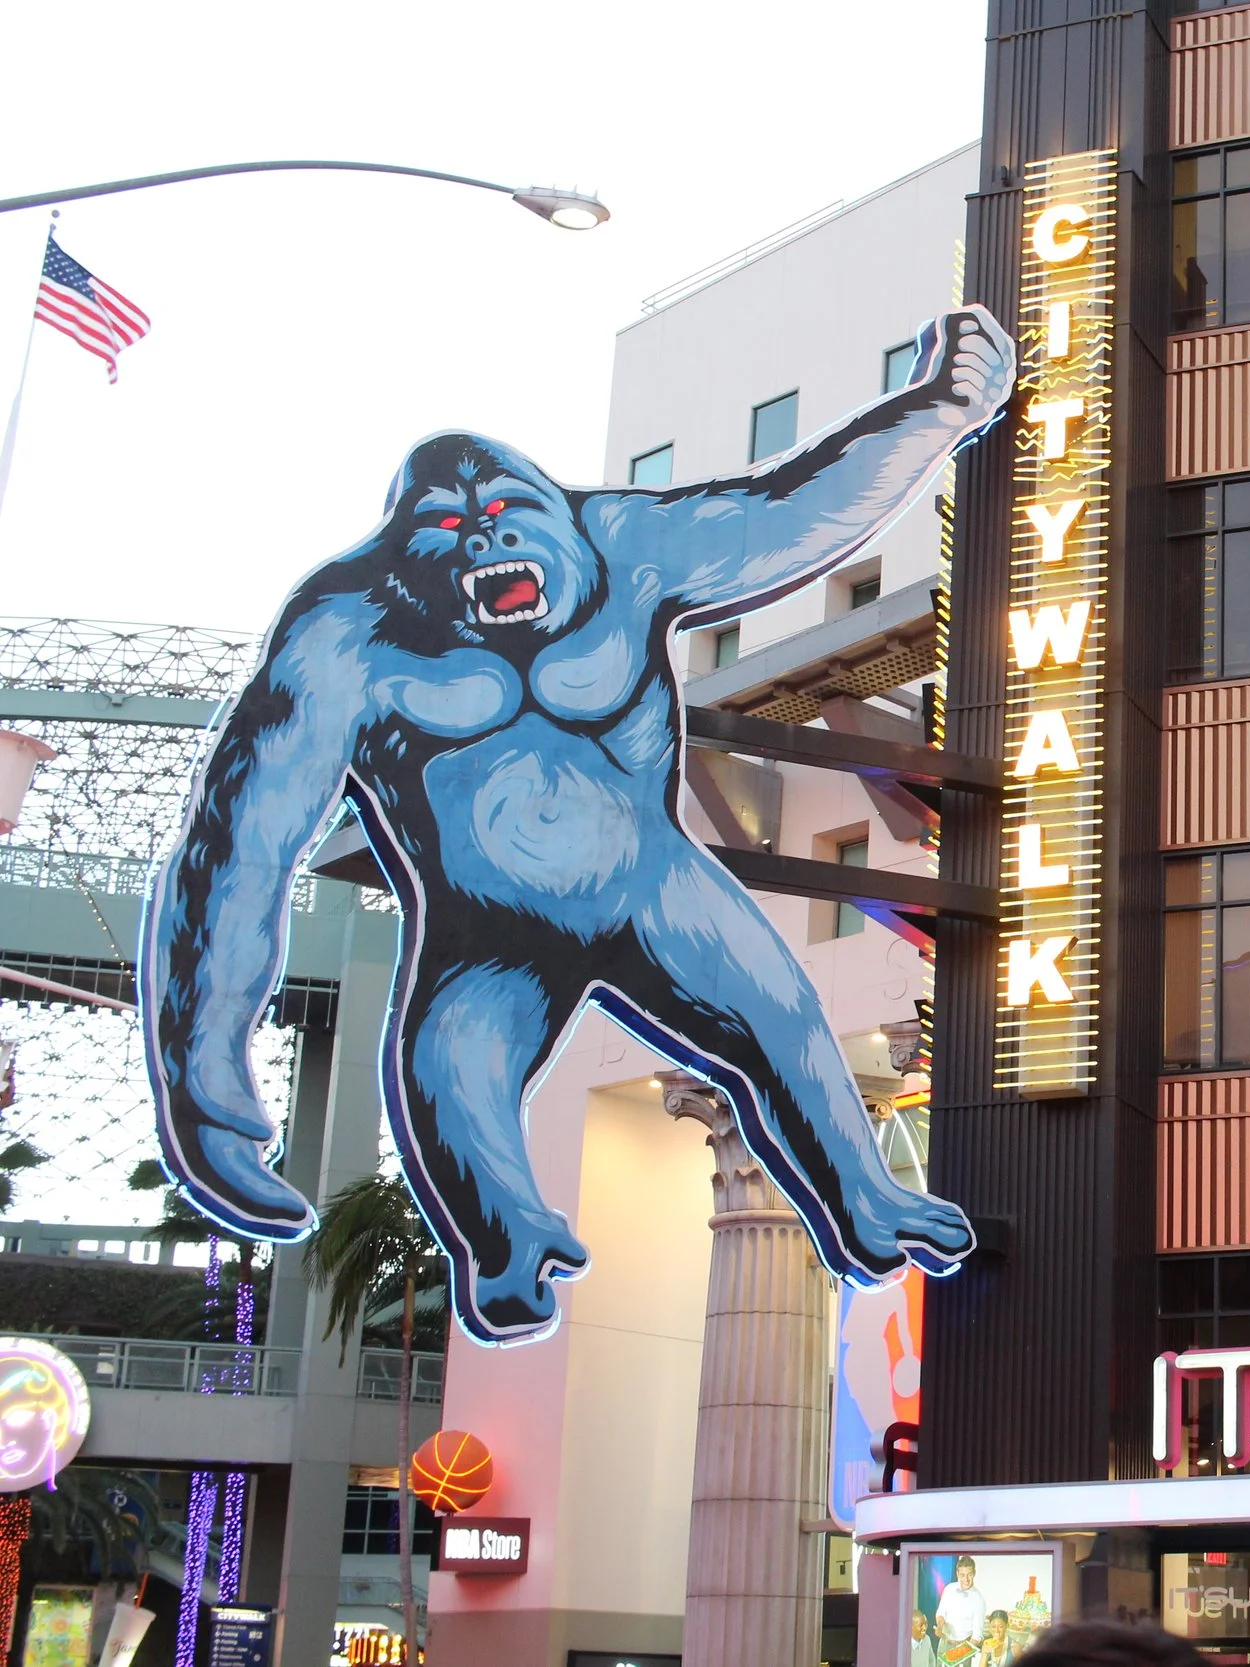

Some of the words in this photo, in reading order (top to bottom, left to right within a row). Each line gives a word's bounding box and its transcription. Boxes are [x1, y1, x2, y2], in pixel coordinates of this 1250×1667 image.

[1006, 203, 1092, 1009] CITYWALK
[445, 1529, 480, 1559] NBA
[482, 1529, 521, 1560] Store
